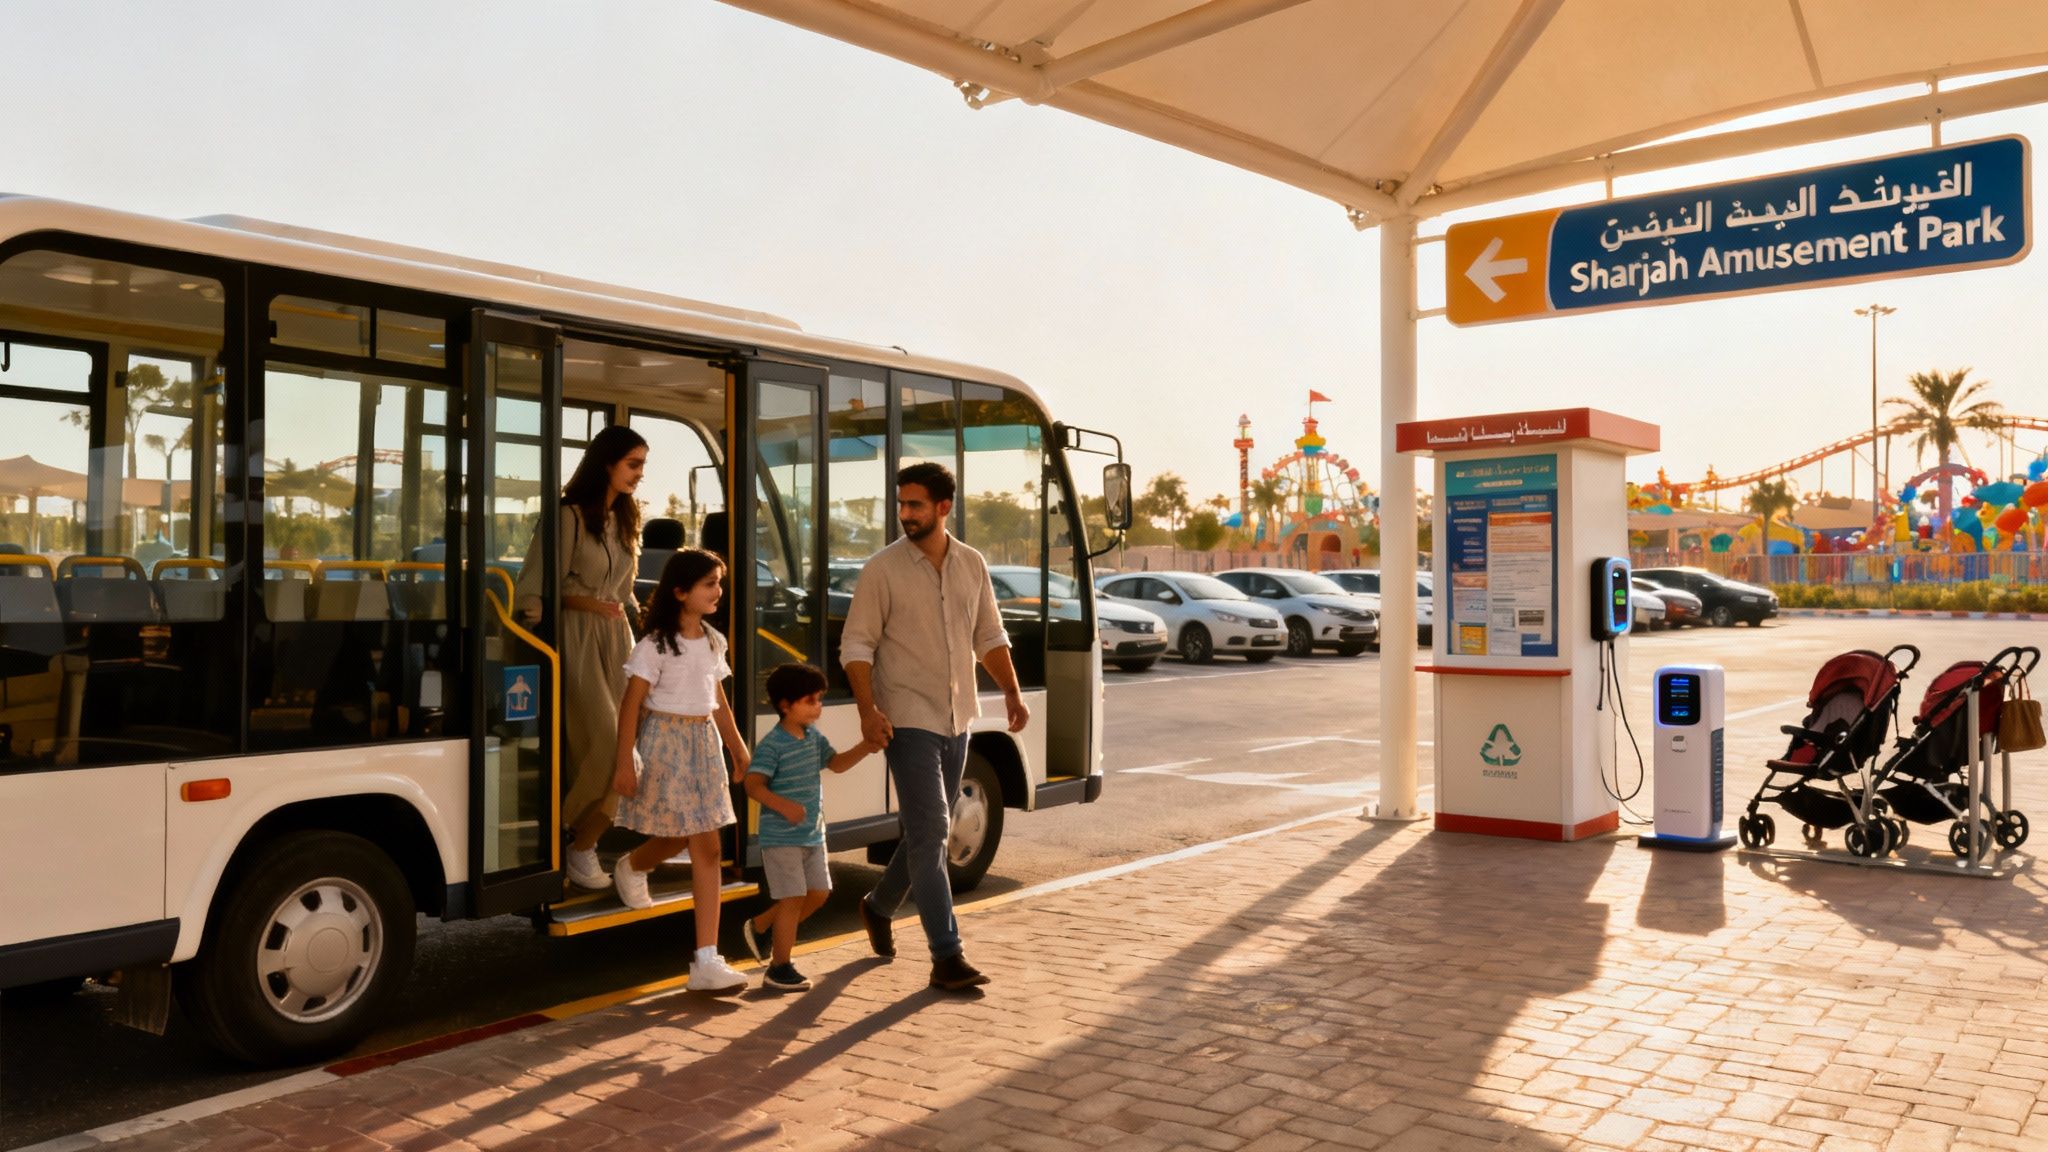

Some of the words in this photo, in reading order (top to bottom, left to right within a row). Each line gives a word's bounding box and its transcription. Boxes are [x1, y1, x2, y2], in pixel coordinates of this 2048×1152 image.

[1570, 249, 1688, 296] Sharjah
[1698, 222, 1908, 277] Amusement
[1919, 207, 2005, 250] Park
